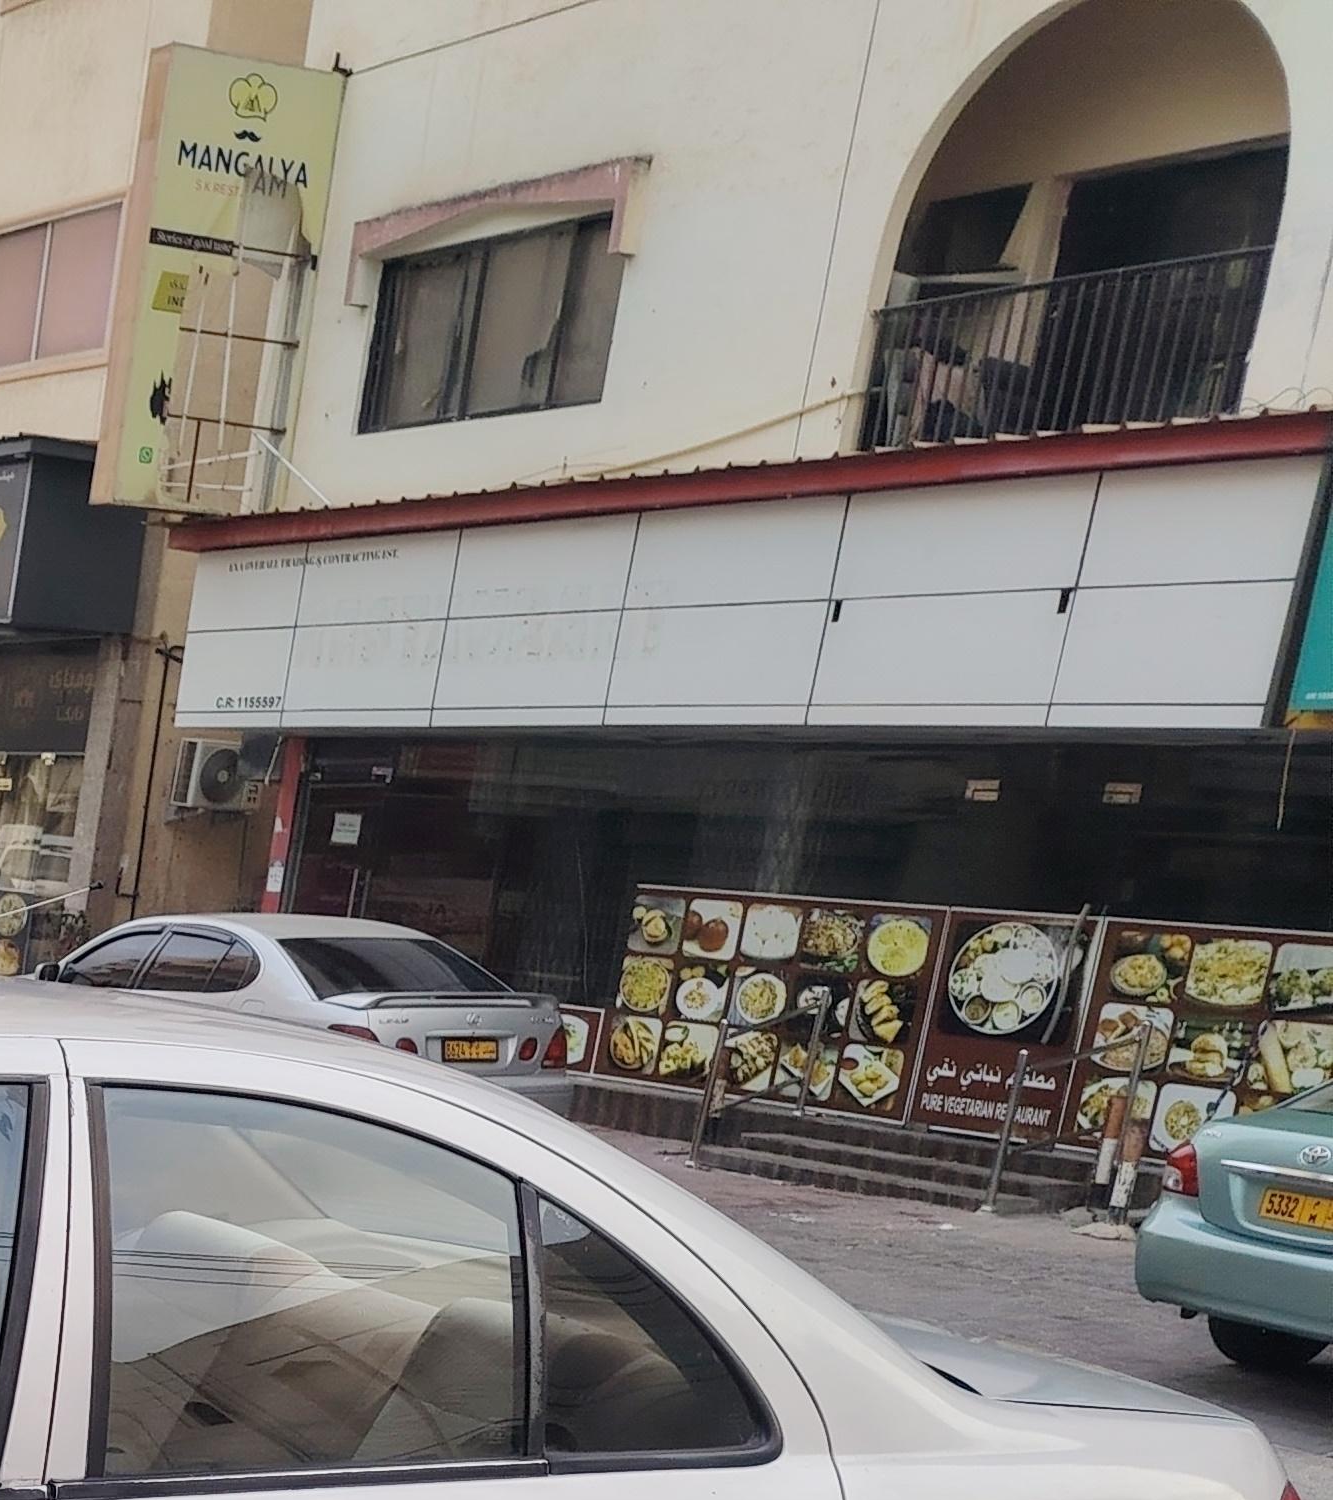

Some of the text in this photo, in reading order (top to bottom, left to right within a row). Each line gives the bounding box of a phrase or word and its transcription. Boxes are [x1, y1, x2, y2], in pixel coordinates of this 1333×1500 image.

[237, 695, 282, 709] 1155597
[926, 1057, 957, 1087] نقي
[960, 1063, 1002, 1091] نباتي
[920, 1092, 1052, 1127] PURE VEGETARIAN REAURANT
[1265, 1193, 1300, 1218] 5332
